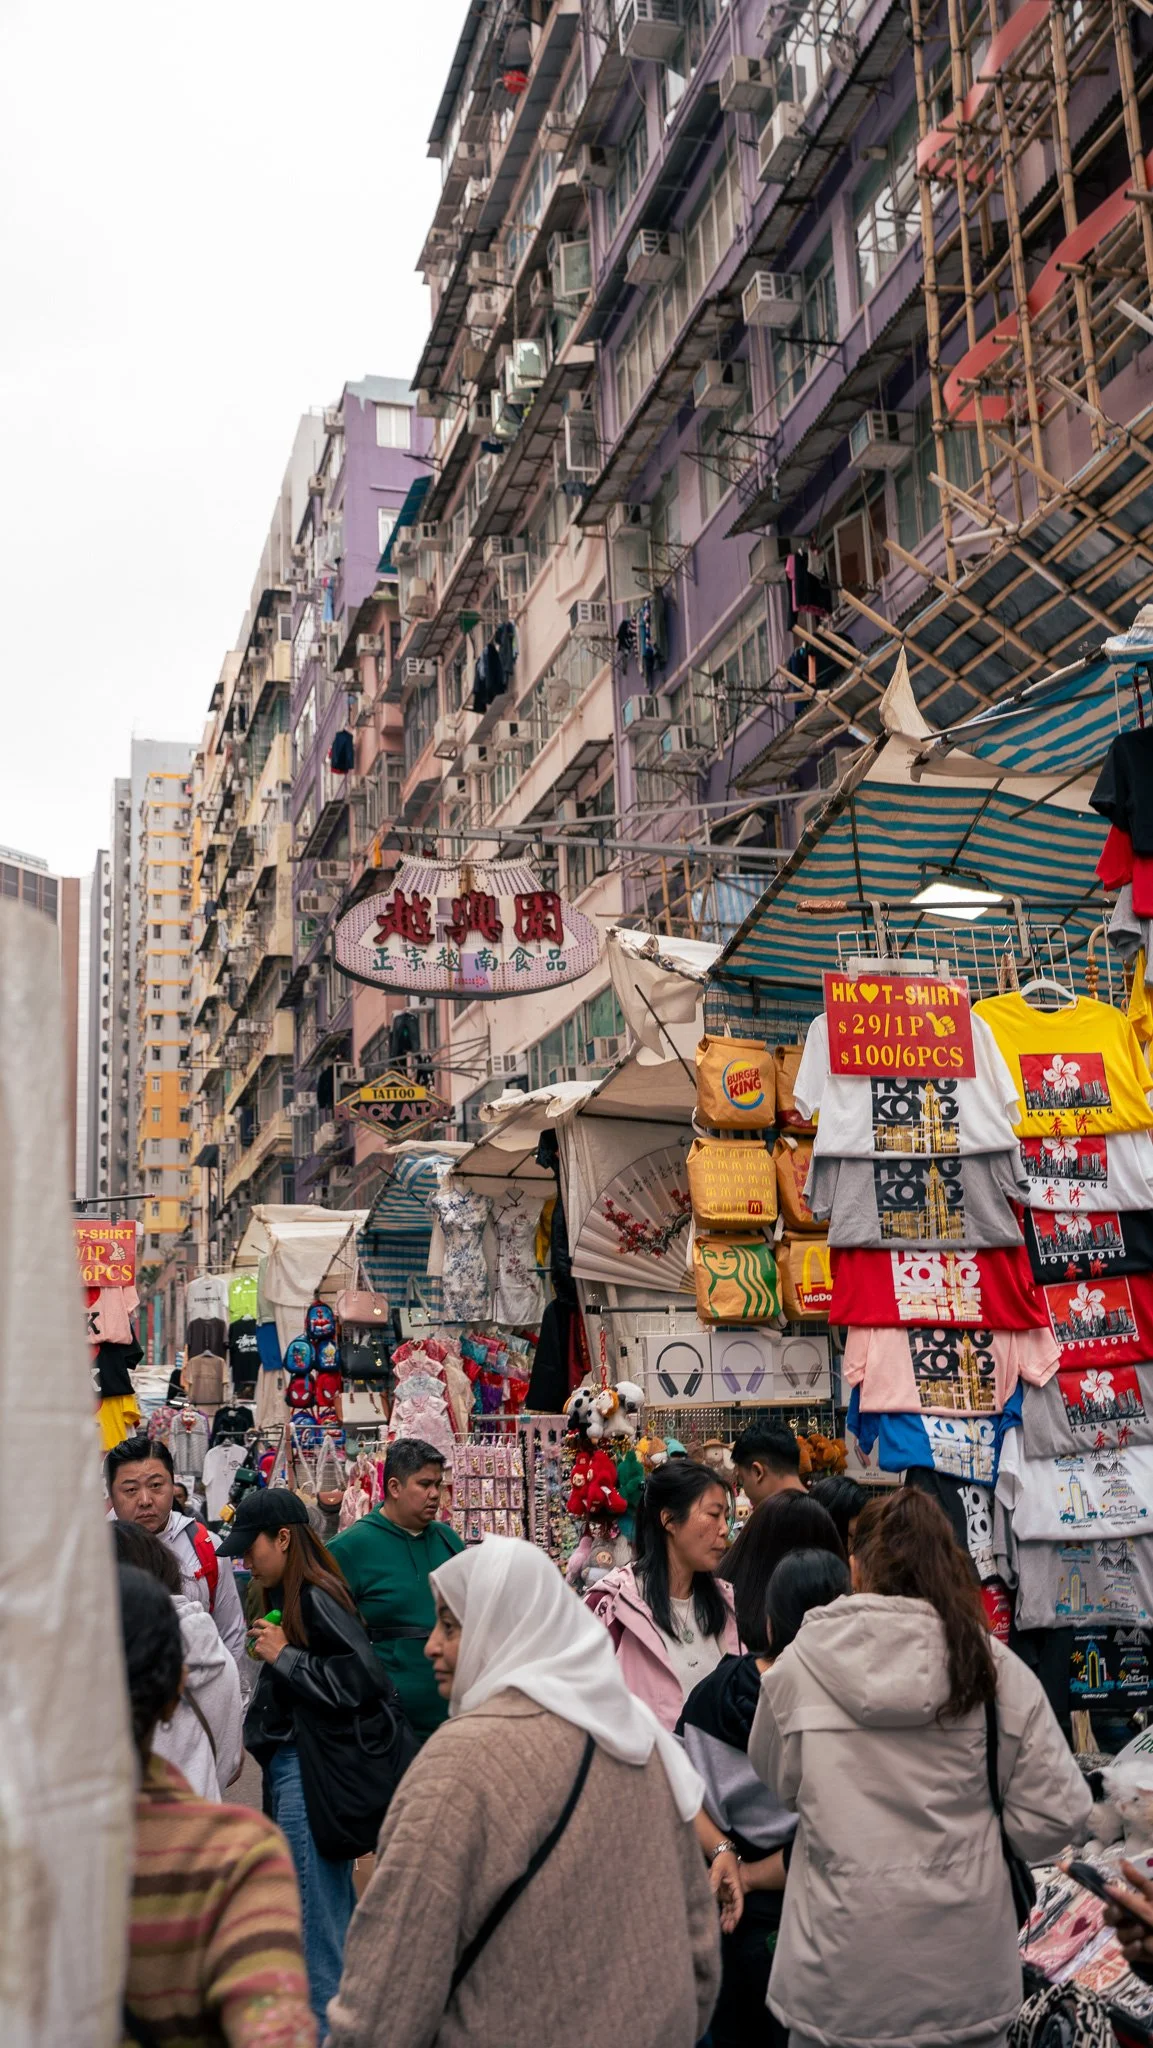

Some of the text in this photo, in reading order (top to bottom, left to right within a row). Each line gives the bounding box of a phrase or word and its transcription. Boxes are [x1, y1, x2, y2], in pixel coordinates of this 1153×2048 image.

[372, 947, 567, 973] 正宗越南食品
[832, 982, 960, 1007] HK T-SHIRT
[727, 1068, 759, 1085] BURGER
[371, 1089, 415, 1099] TATTOO
[730, 1077, 761, 1098] KING
[400, 1102, 452, 1120] ALTAR
[872, 1095, 959, 1120] KONG
[1027, 1107, 1113, 1118] HONG KONG
[1050, 1114, 1093, 1137] 香港
[875, 1180, 963, 1205] KONG
[1031, 1178, 1108, 1189] ONG KONG
[1042, 1186, 1086, 1207] 香港
[77, 1229, 133, 1239] T-SHIRT
[1040, 1250, 1126, 1265] HONG KONG
[892, 1261, 981, 1287] KONG
[803, 1293, 832, 1303] McDo
[1101, 1334, 1140, 1347] KONG
[910, 1349, 995, 1376] KONG
[921, 1415, 996, 1446] KONG
[1070, 1417, 1150, 1434] HONG KONG
[967, 1513, 993, 1544] KO
